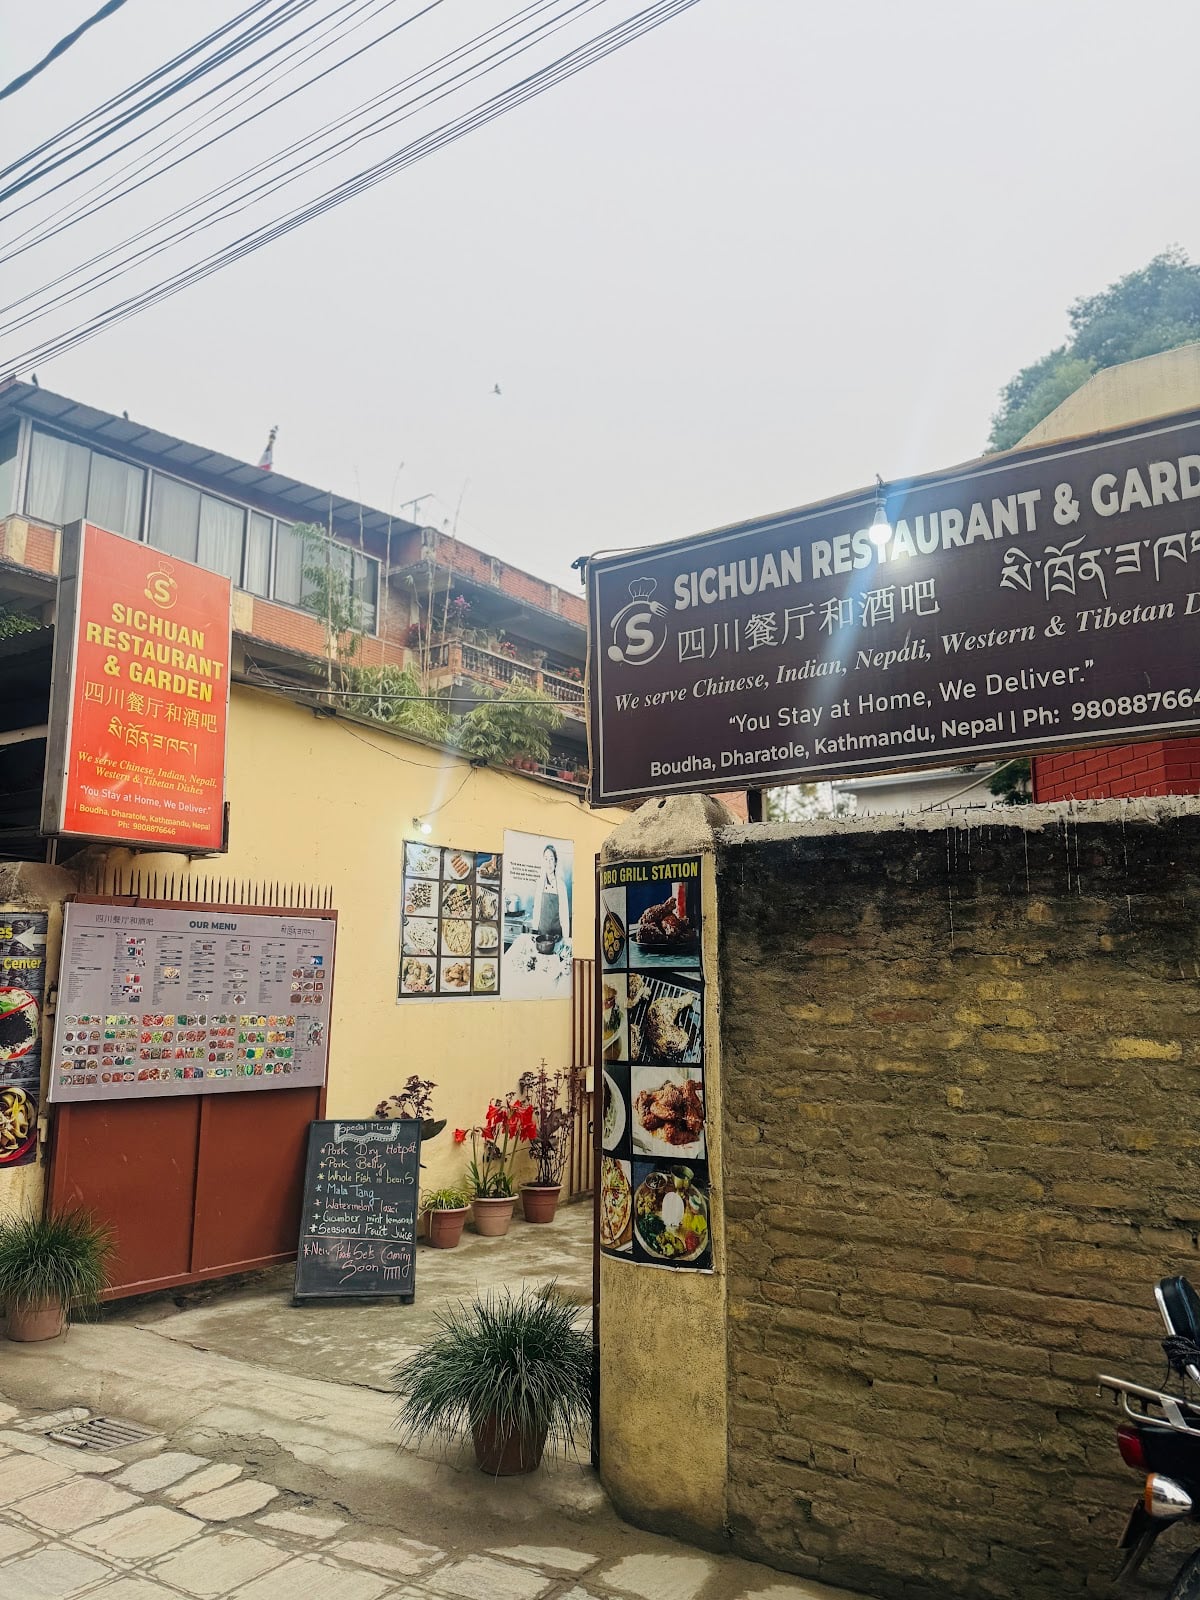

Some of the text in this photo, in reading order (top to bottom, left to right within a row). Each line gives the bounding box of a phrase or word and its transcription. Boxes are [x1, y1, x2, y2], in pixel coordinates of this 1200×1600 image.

[674, 546, 802, 610] SICHUAN
[1053, 483, 1081, 526] &
[111, 602, 205, 650] SICHUAN
[678, 577, 940, 662] 四川餐厅和酒吧
[86, 621, 224, 680] RESTAURANT
[615, 694, 640, 711] We
[644, 688, 687, 707] serve
[693, 673, 769, 698] Chinese,
[776, 659, 847, 684] Indian,
[855, 639, 931, 670] Nepali,
[941, 622, 1036, 655] Western
[1044, 615, 1067, 638] &
[1076, 601, 1175, 633] Tibetan
[103, 655, 213, 702] & GARDEN
[85, 681, 217, 733] 四川餐厅和酒吧
[730, 659, 1094, 733] “You Stay at Home, We Deliver.”
[650, 755, 716, 777] Boudha,
[720, 742, 810, 768] Dharatole,
[814, 724, 936, 755] Kathmandu,
[941, 711, 1004, 738] Nepal
[1023, 707, 1060, 727] Ph:
[78, 751, 218, 788] We serve Chinese, Indian, Nepali,
[95, 766, 204, 795] Western & Tibetan Dishes
[102, 789, 121, 802] Stay
[134, 795, 161, 808] Home,
[164, 799, 176, 808] We
[79, 804, 110, 817] Boudha,
[111, 809, 148, 822] Dharatole,
[150, 815, 191, 829] Kathmandu,
[118, 821, 176, 835] Ph: 9808876646
[620, 866, 649, 882] GRILL
[652, 862, 699, 881] STATION
[189, 920, 237, 931] OUR MENU
[3, 957, 42, 970] Center
[326, 1157, 386, 1175] Pork Belly
[328, 1170, 352, 1182] Whole
[355, 1171, 371, 1183] Fish
[323, 1210, 360, 1222] Cucumber
[366, 1213, 384, 1224] mint
[318, 1222, 413, 1240] Seasonal Fruit Juice
[339, 1260, 379, 1284] Soon
